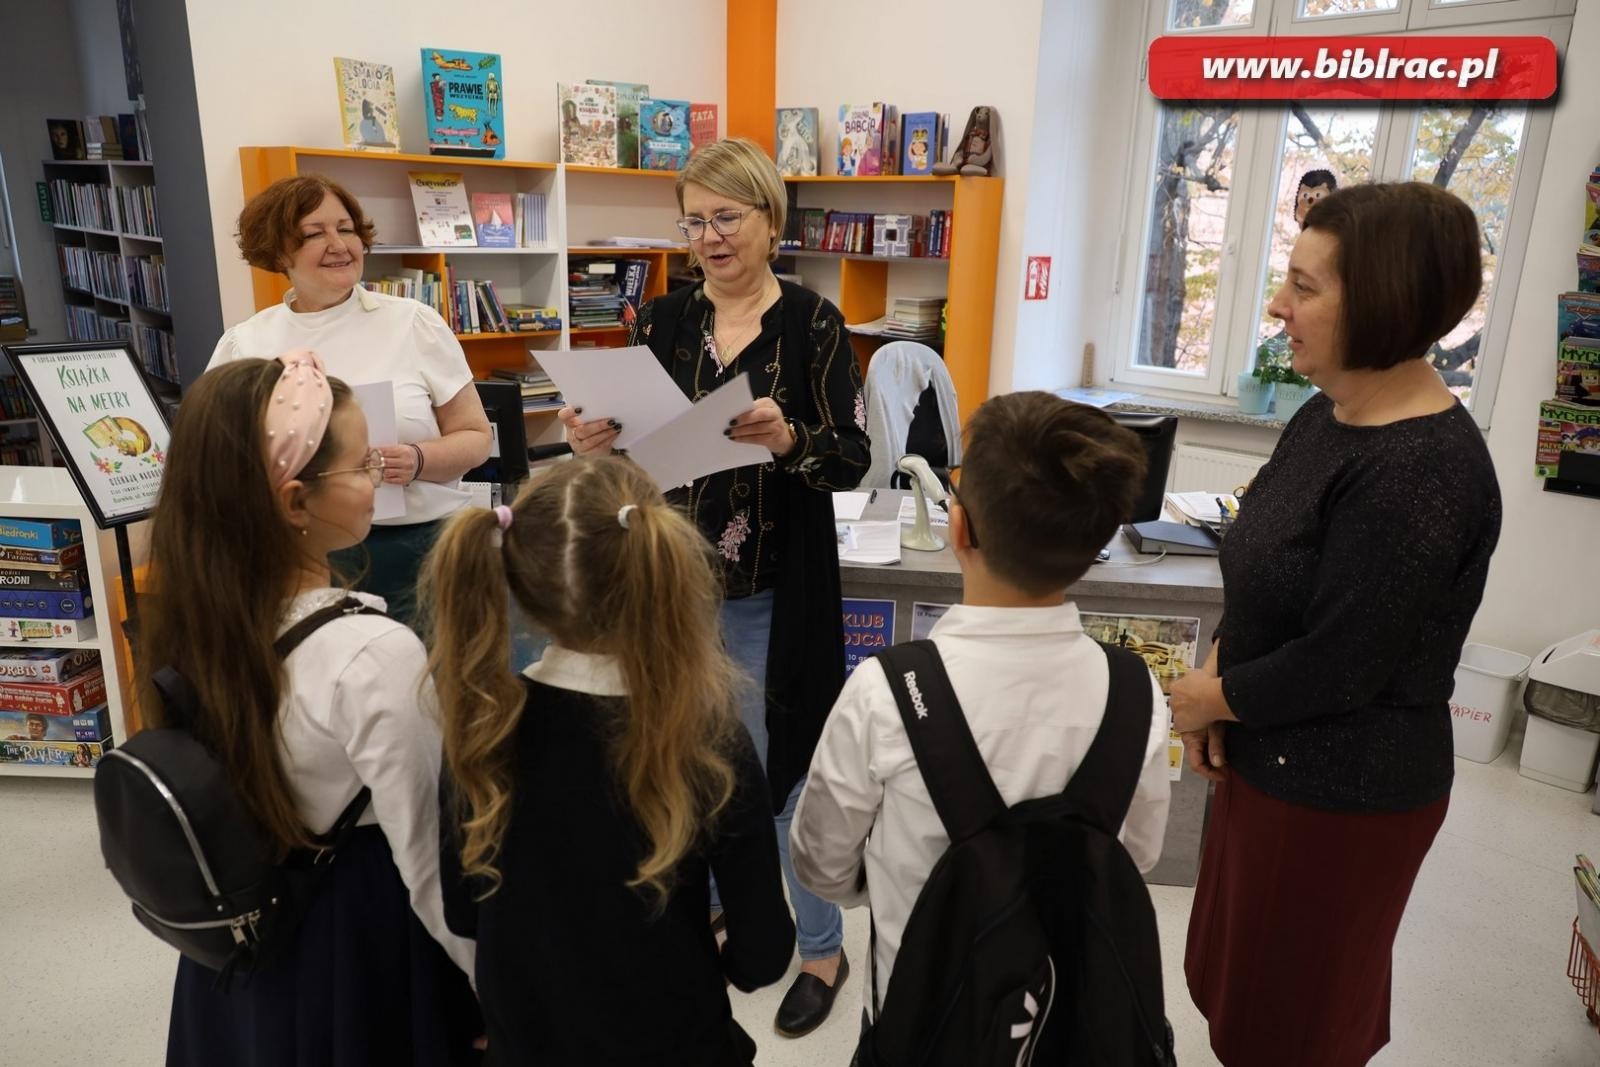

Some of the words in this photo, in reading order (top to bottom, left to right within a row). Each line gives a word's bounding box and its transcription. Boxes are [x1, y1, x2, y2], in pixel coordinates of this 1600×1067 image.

[449, 82, 483, 96] PRAWIE
[625, 264, 638, 297] WIELKA
[57, 365, 110, 389] KSIĄŻKA
[67, 396, 87, 413] NA
[90, 392, 130, 410] METRY
[904, 671, 928, 720] Reebok
[1450, 703, 1492, 723] PAPIER
